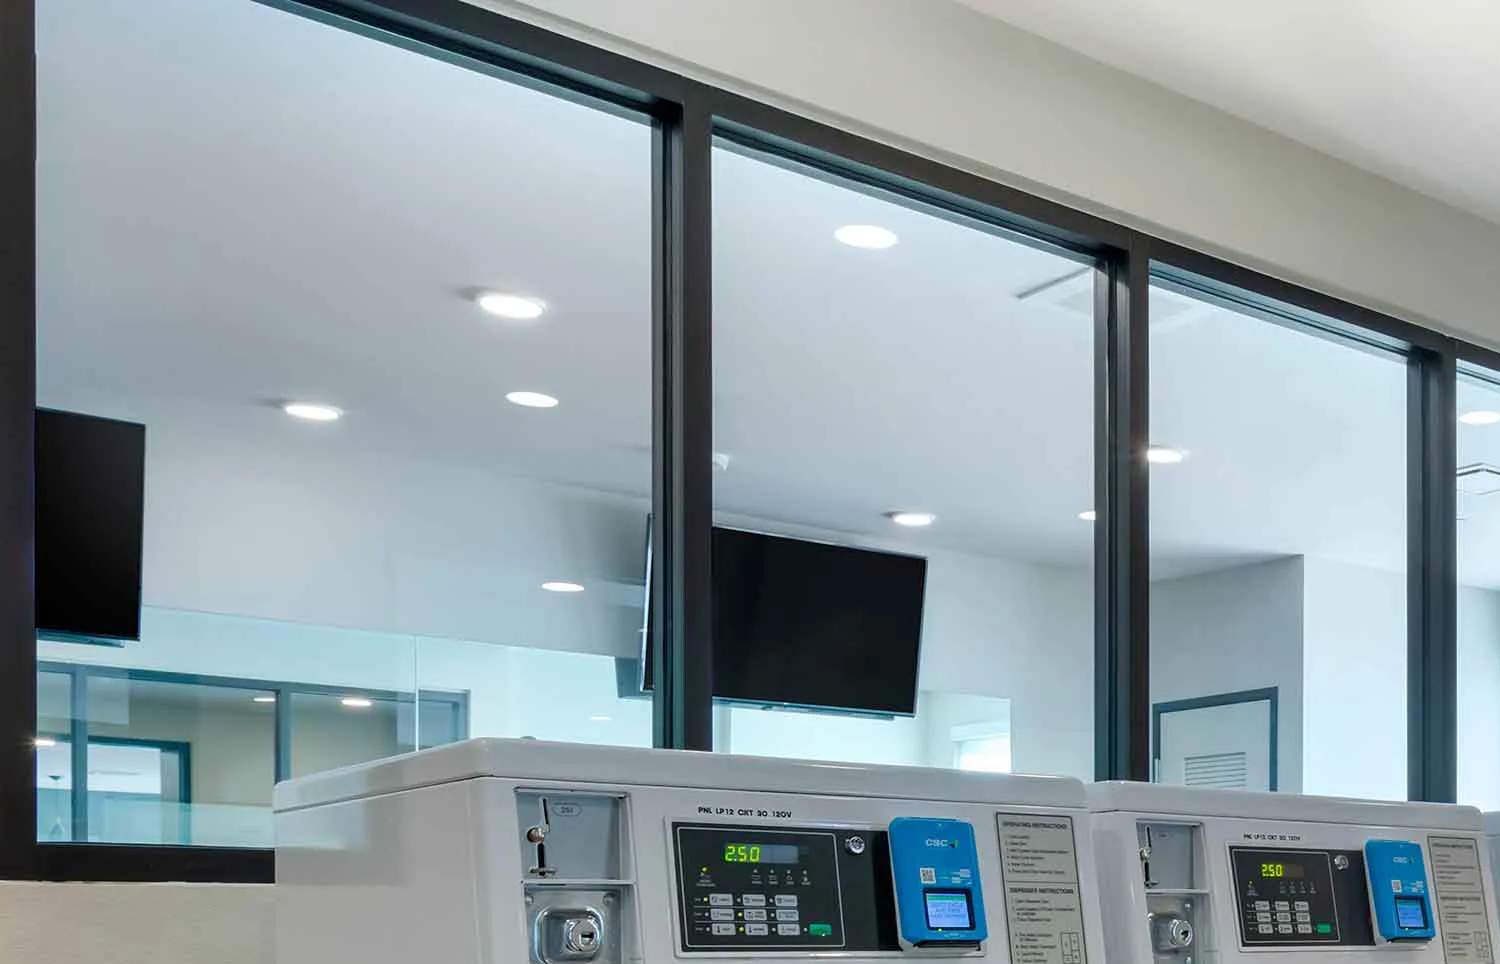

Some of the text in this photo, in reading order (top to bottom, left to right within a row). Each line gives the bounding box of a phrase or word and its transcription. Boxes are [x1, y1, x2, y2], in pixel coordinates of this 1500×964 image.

[697, 806, 713, 815] PNL
[715, 807, 734, 816] LP12
[772, 810, 792, 819] 120V
